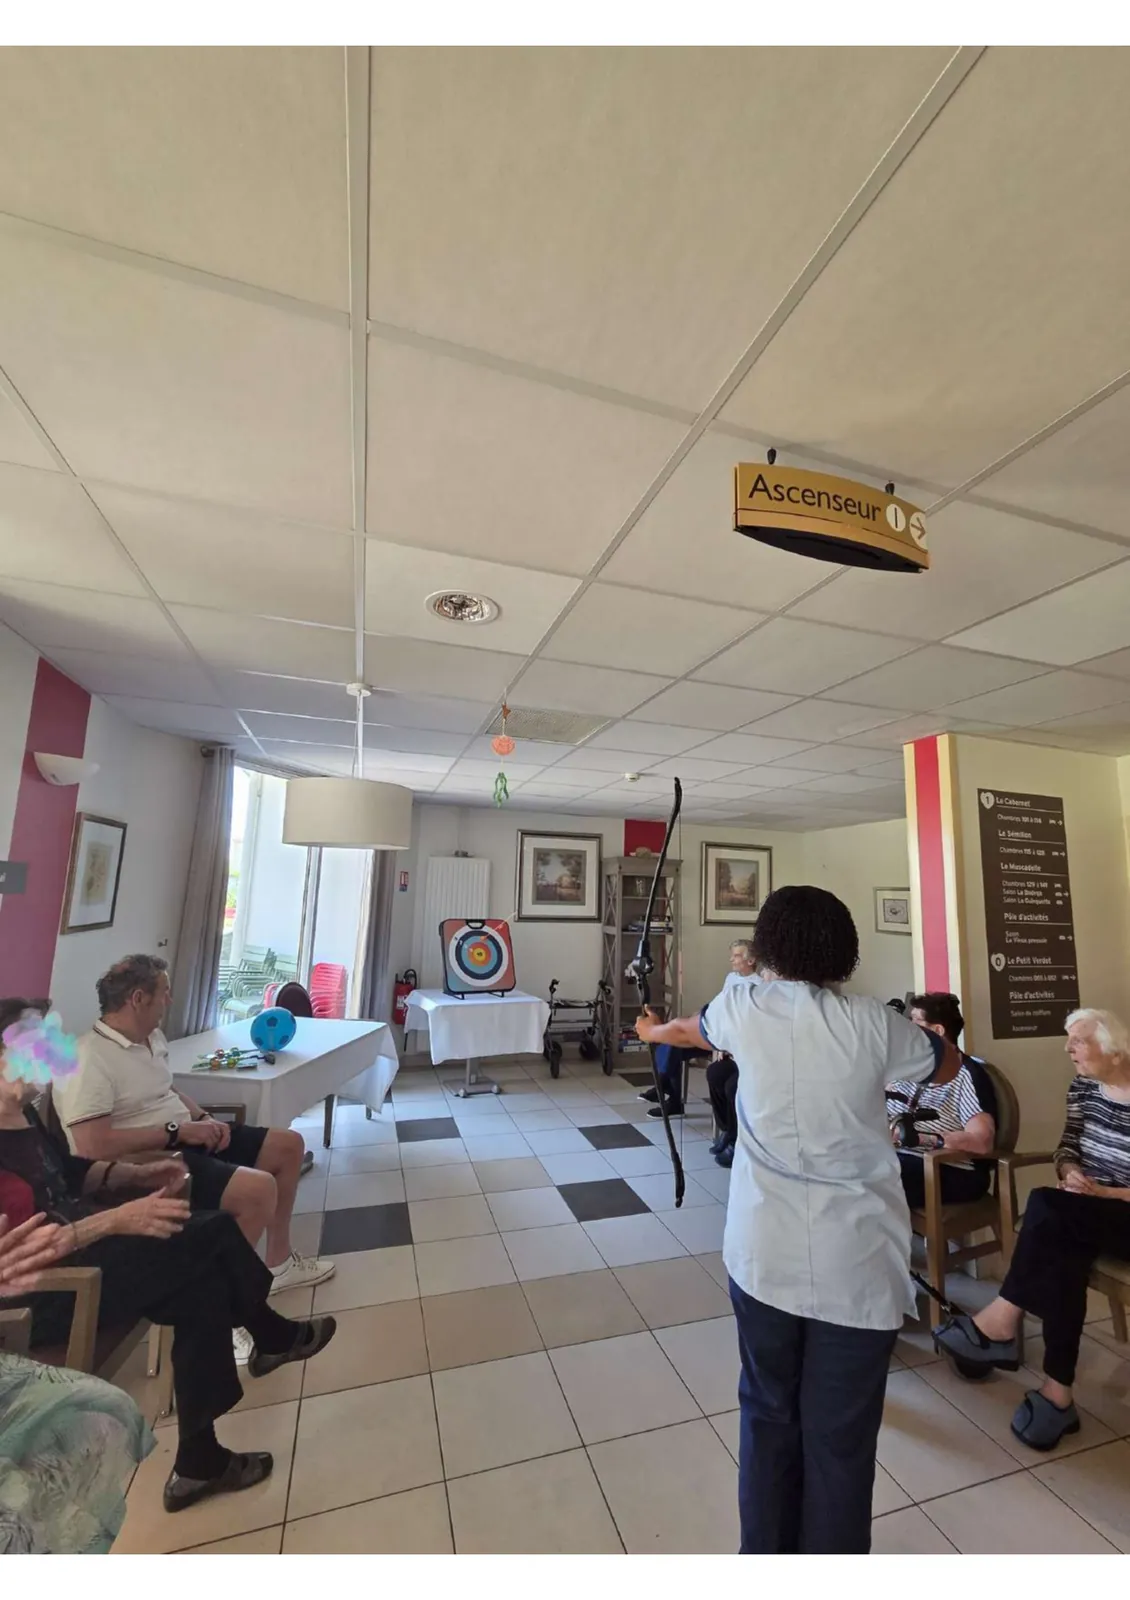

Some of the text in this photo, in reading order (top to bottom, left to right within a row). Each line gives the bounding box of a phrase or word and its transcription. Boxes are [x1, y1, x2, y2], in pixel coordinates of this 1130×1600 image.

[748, 473, 882, 521] Ascenseur
[1005, 798, 1031, 807] Cabernet
[1007, 830, 1032, 839] Sémillon
[1004, 912, 1049, 921] Pôle d'activités
[1007, 956, 1015, 965] Le
[1016, 956, 1031, 965] Petit
[1032, 956, 1052, 965] Verdot
[1009, 990, 1055, 1000] Pôle d'activités
